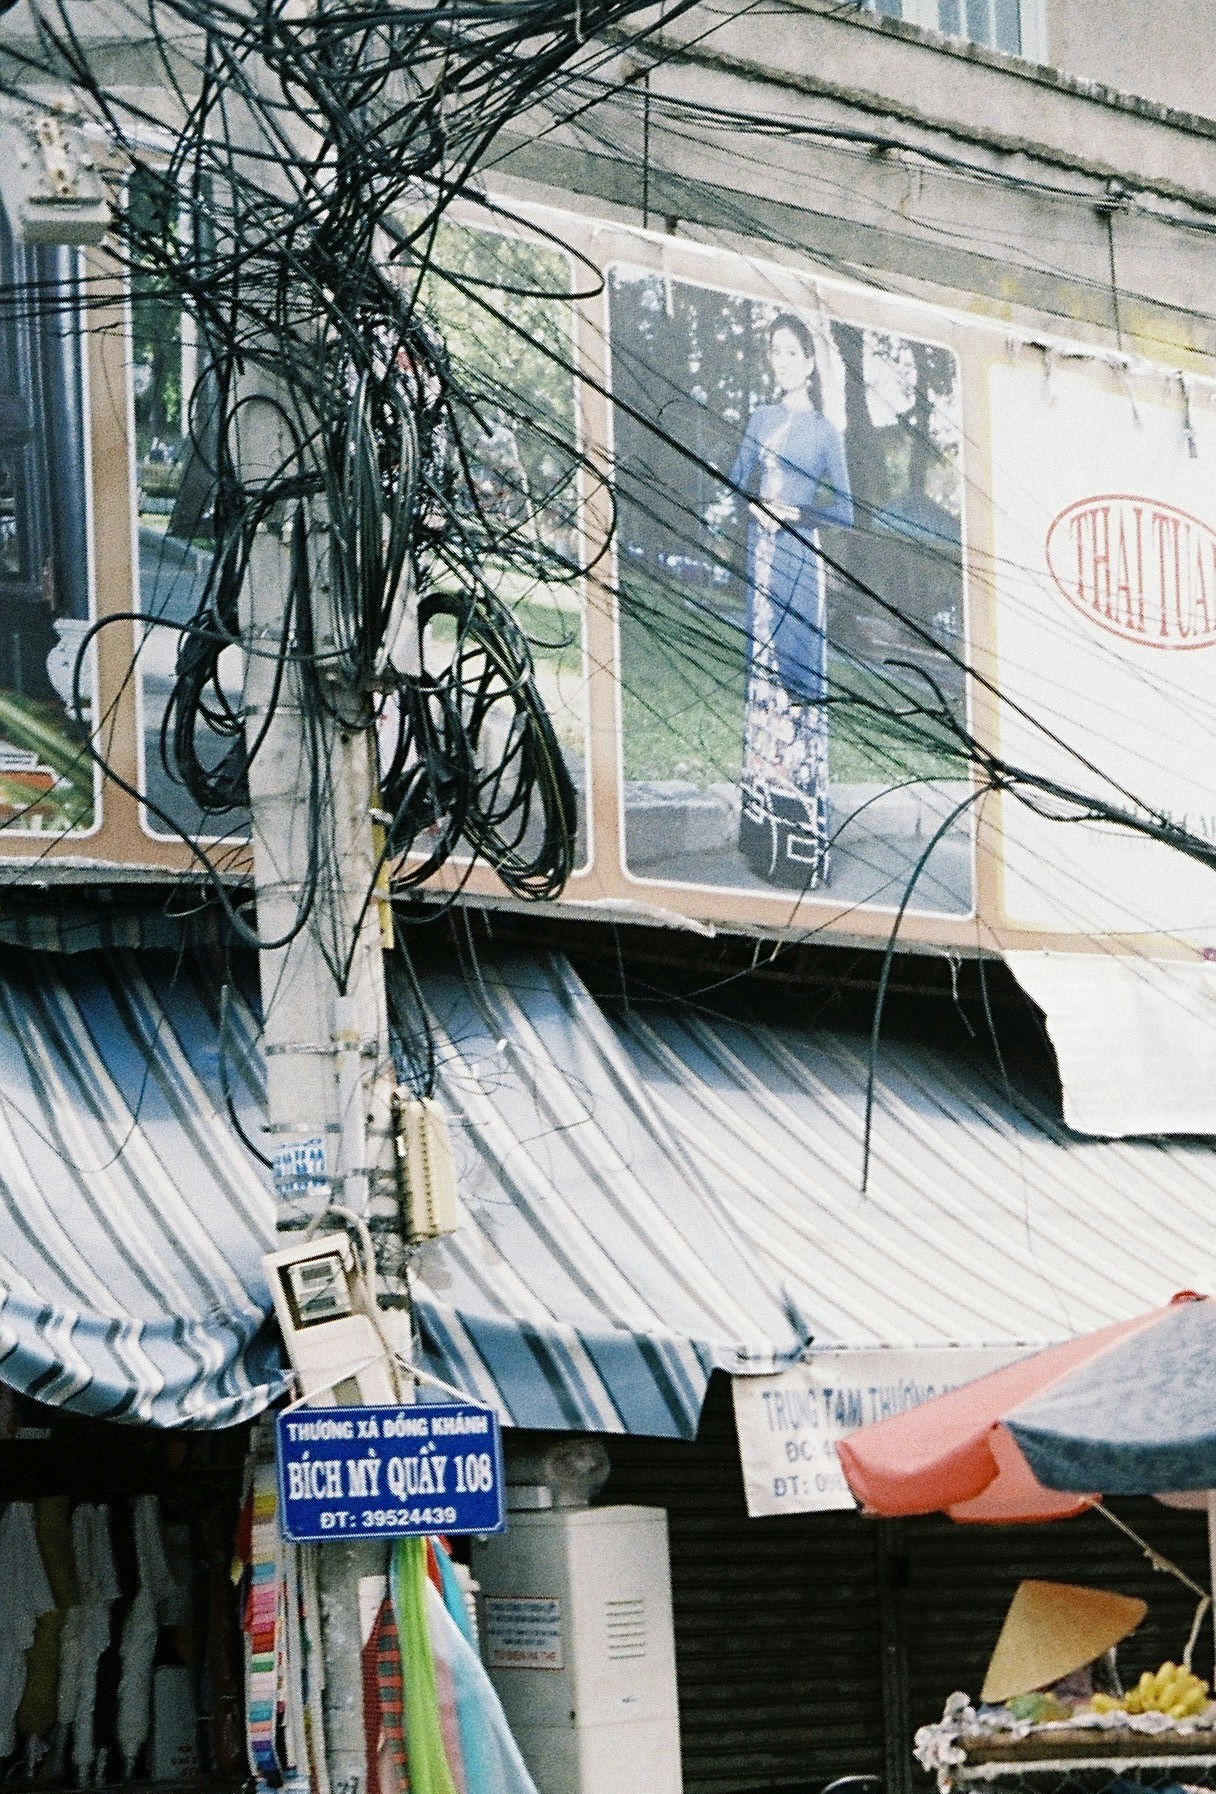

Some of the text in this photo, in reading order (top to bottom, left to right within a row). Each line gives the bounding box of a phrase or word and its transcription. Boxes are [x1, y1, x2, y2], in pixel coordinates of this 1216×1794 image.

[287, 1420, 353, 1441] THƯƠNG
[357, 1415, 379, 1438] XÁ
[431, 1412, 488, 1435] KHÁNH
[287, 1450, 343, 1500] BÍCH
[347, 1448, 381, 1497] MỲ
[453, 1453, 493, 1493] 108
[320, 1507, 457, 1529] ĐT: 39524439
